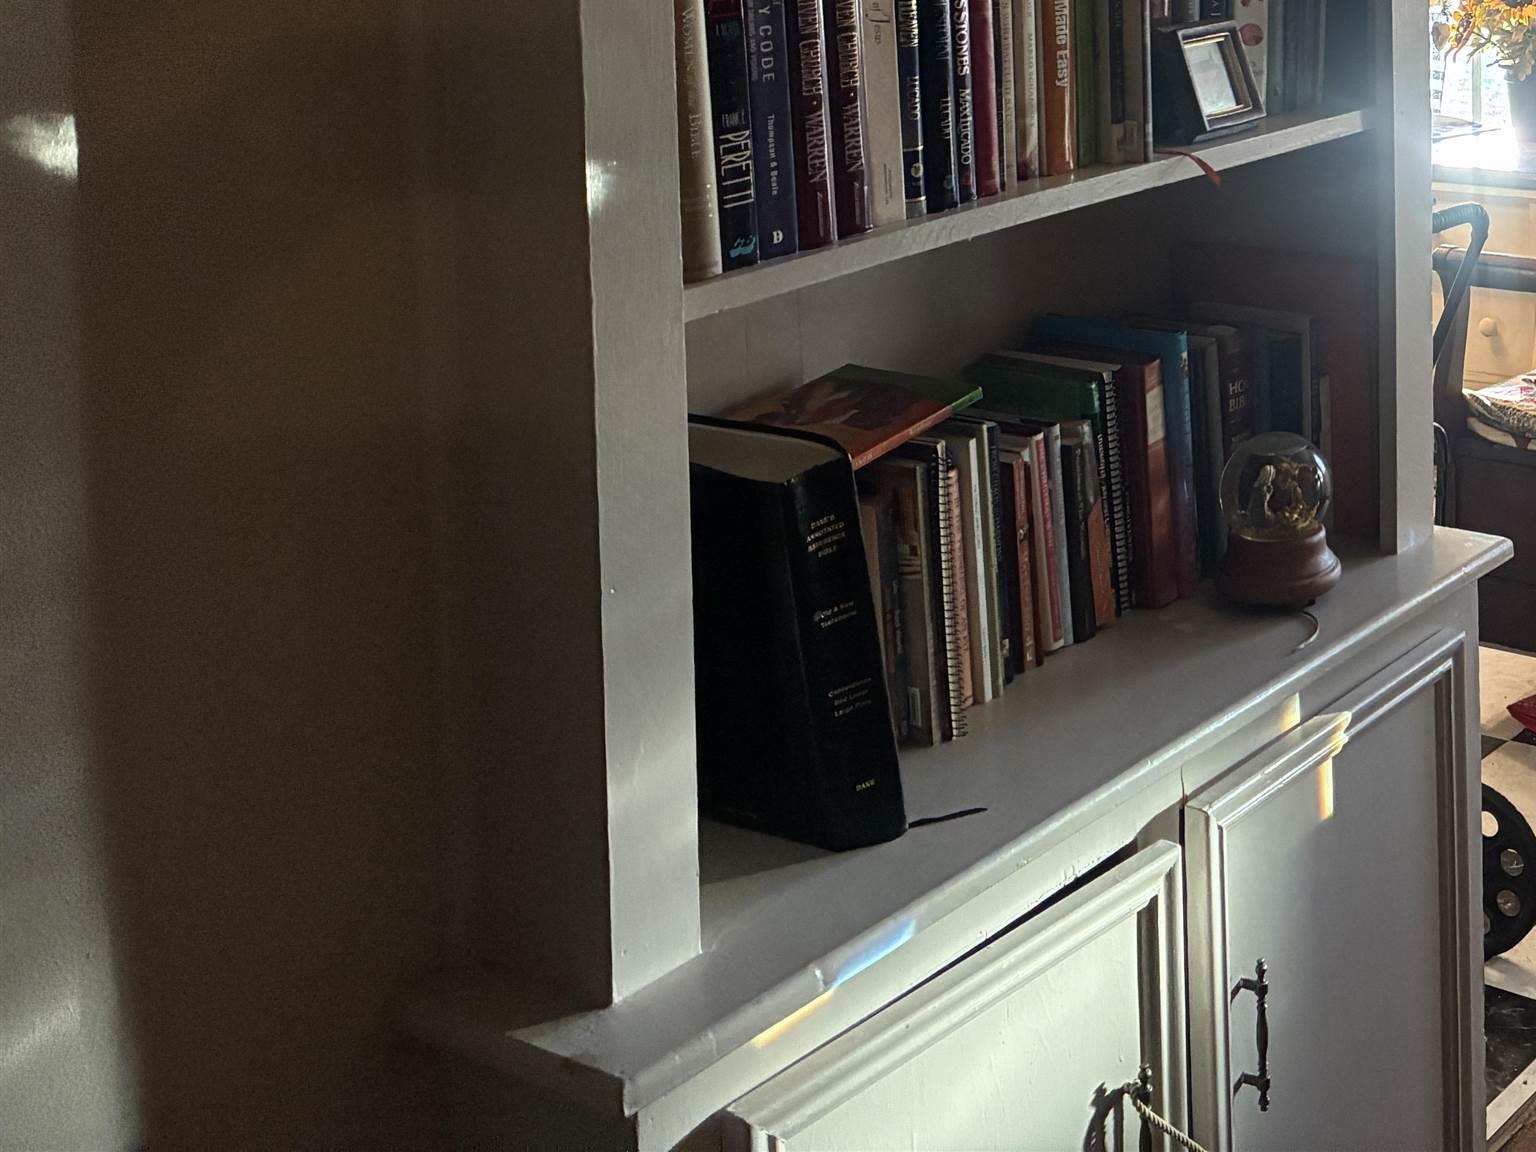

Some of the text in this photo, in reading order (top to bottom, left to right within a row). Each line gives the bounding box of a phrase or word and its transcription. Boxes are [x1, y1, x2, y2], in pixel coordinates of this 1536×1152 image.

[953, 11, 969, 77] STONES
[1053, 0, 1069, 44] Made
[756, 24, 778, 83] CODE
[798, 39, 823, 96] CHURCH
[835, 31, 861, 88] CHURCH
[1053, 48, 1069, 86] Easy
[959, 89, 971, 117] MAX
[804, 111, 828, 185] WARREN
[841, 103, 863, 174] WARREN
[717, 129, 755, 208] PERETTI
